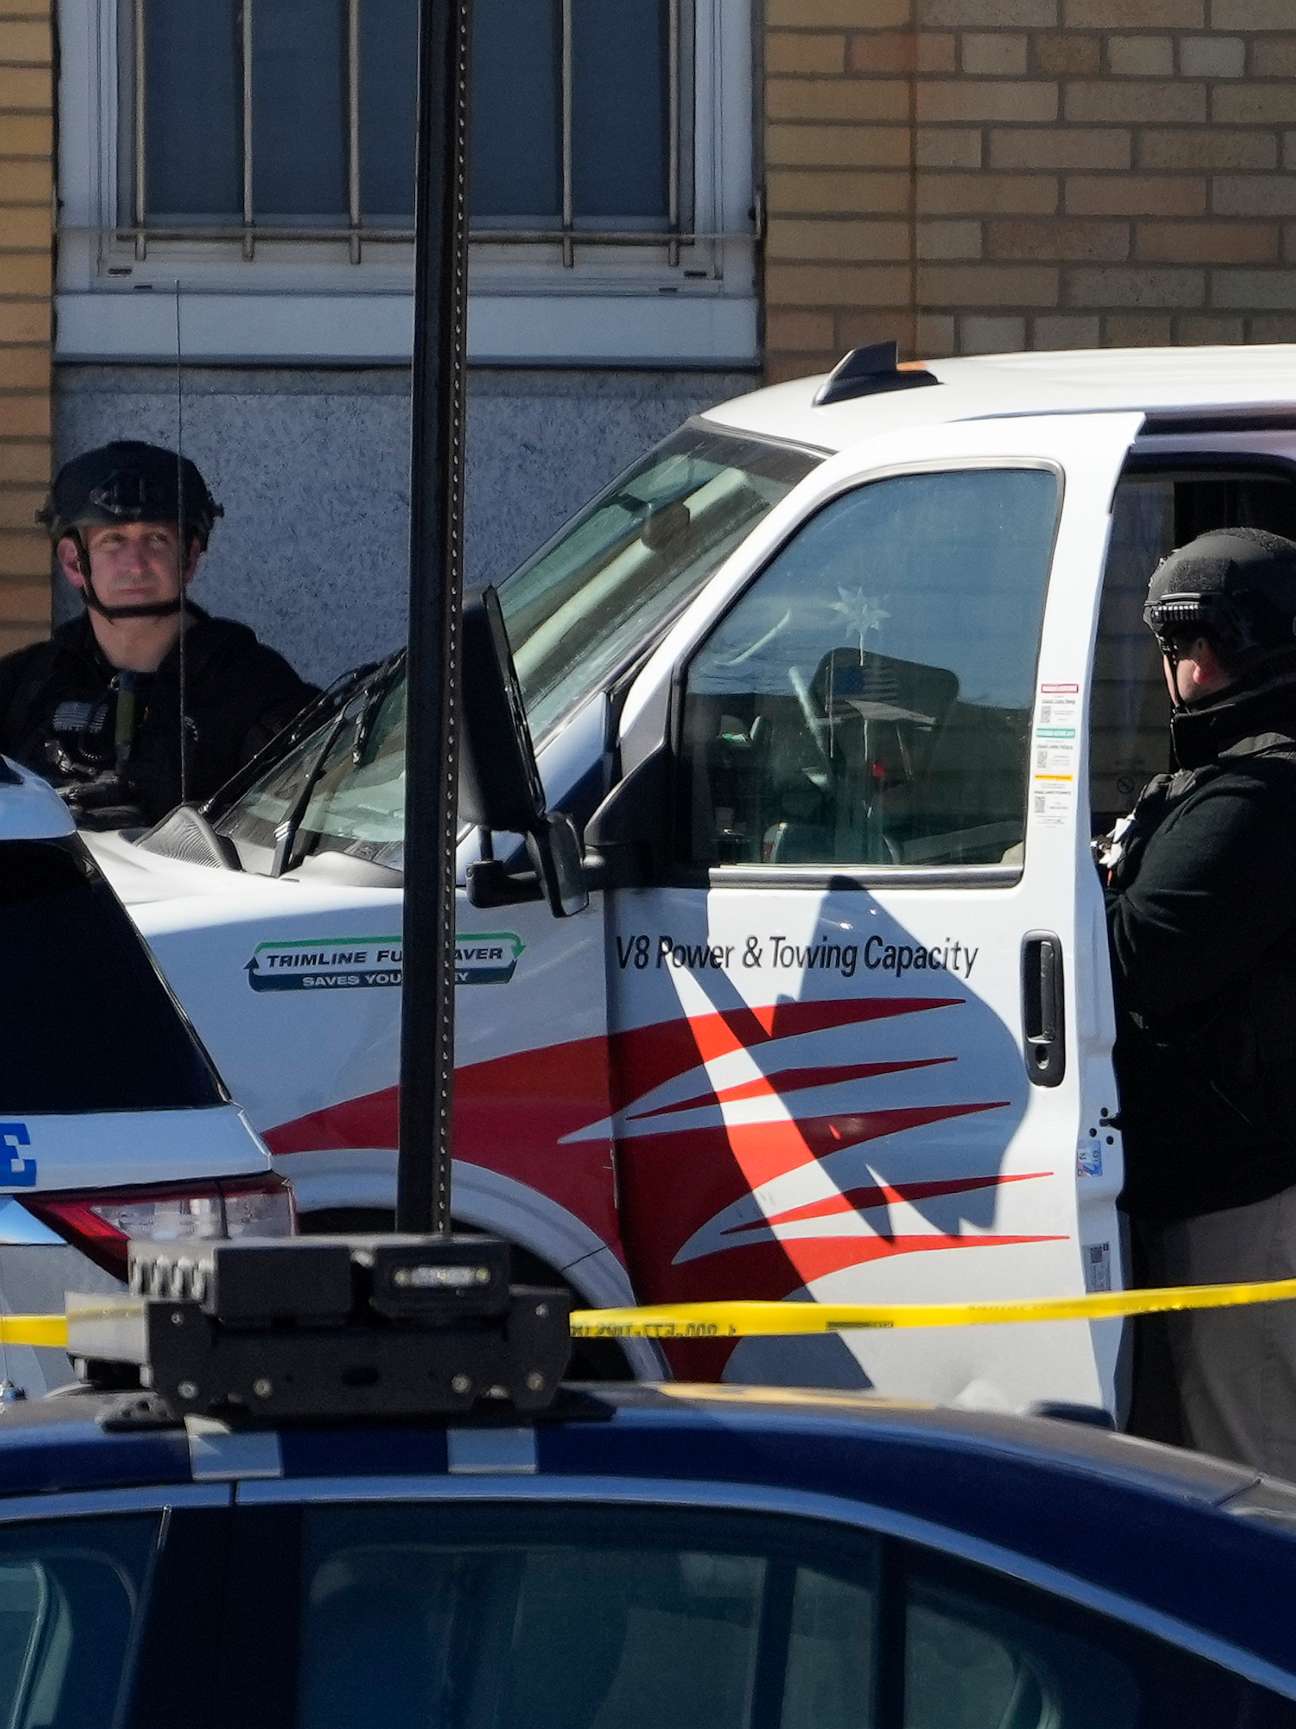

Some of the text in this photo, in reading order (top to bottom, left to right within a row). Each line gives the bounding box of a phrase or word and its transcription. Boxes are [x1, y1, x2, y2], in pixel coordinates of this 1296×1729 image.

[266, 948, 503, 968] TRIMLINE FU AVER
[615, 935, 980, 979] V8 Power & Towing Capacity
[302, 975, 360, 987] SAVES
